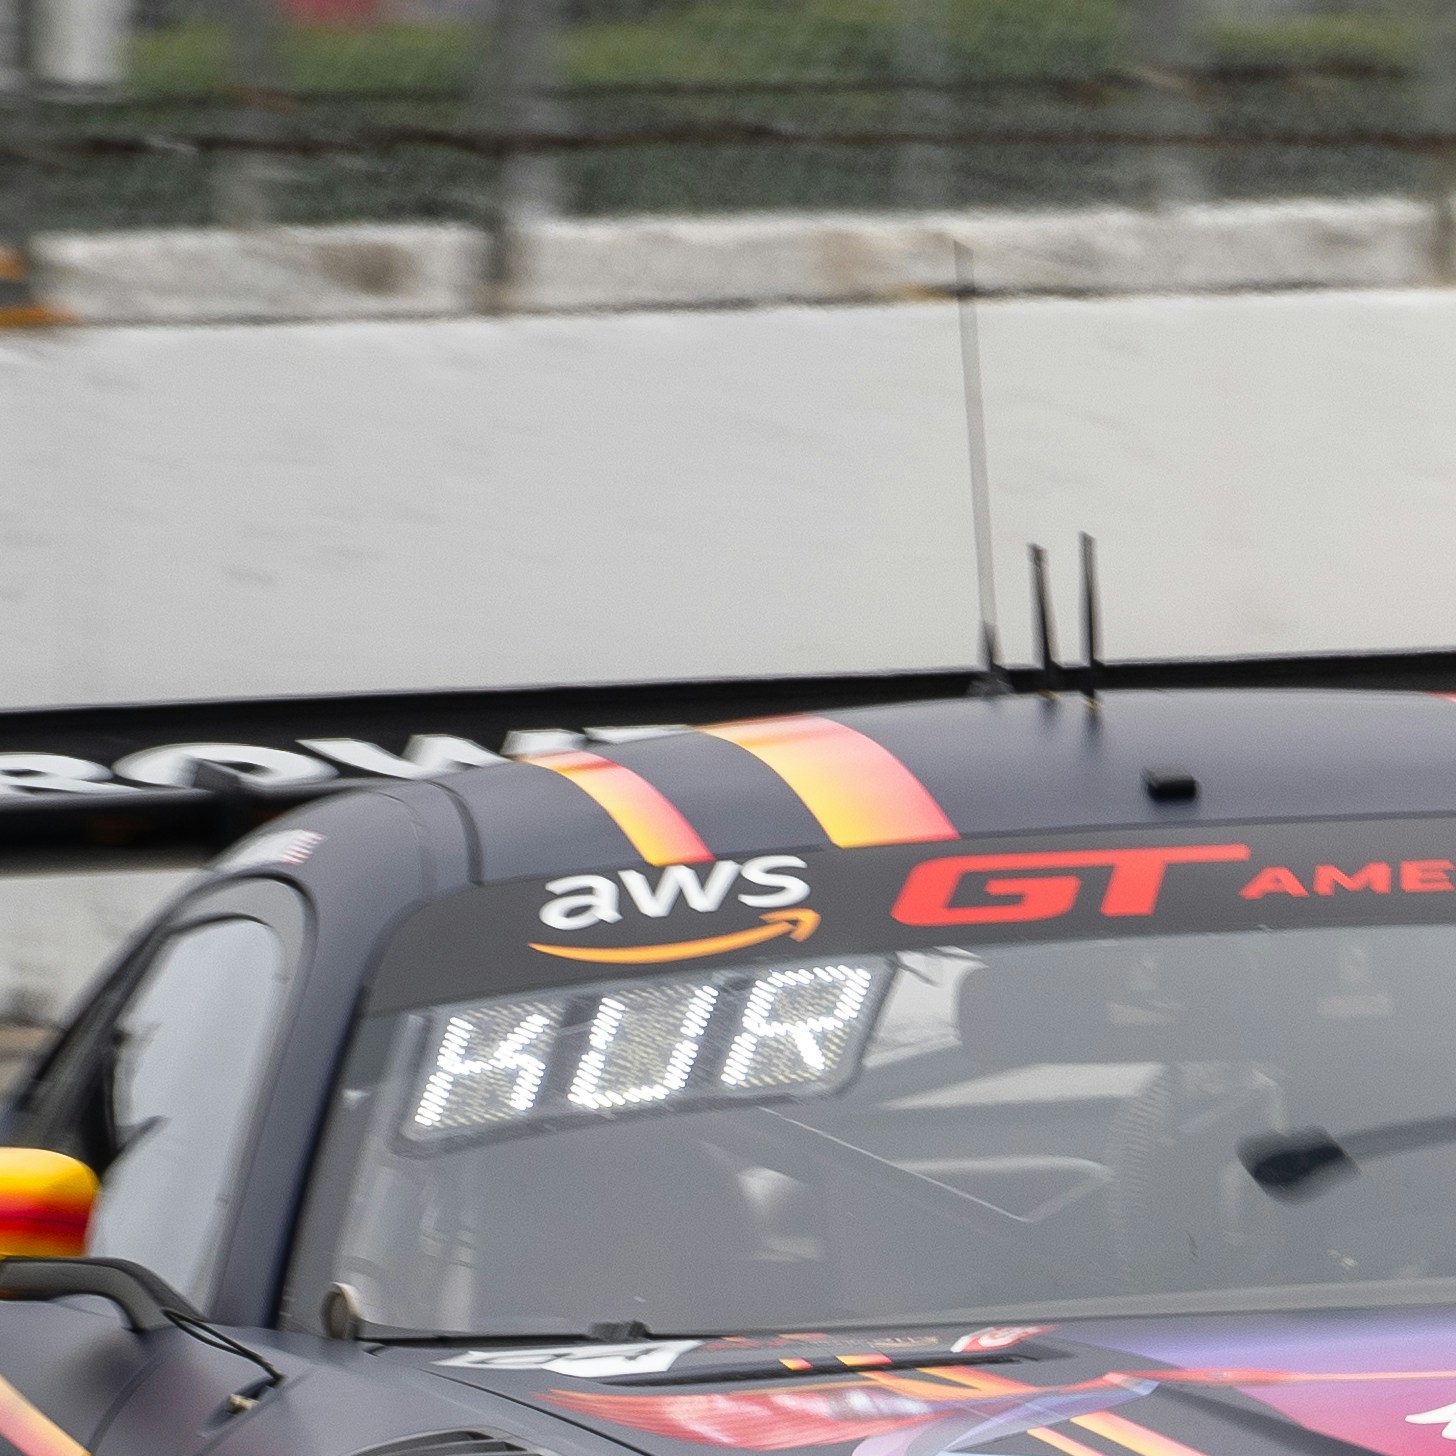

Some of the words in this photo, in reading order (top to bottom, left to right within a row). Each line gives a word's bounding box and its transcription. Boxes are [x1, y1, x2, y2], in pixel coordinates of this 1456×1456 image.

[539, 854, 811, 930] aws
[891, 843, 1251, 927] GT
[414, 965, 872, 1127] KUR
